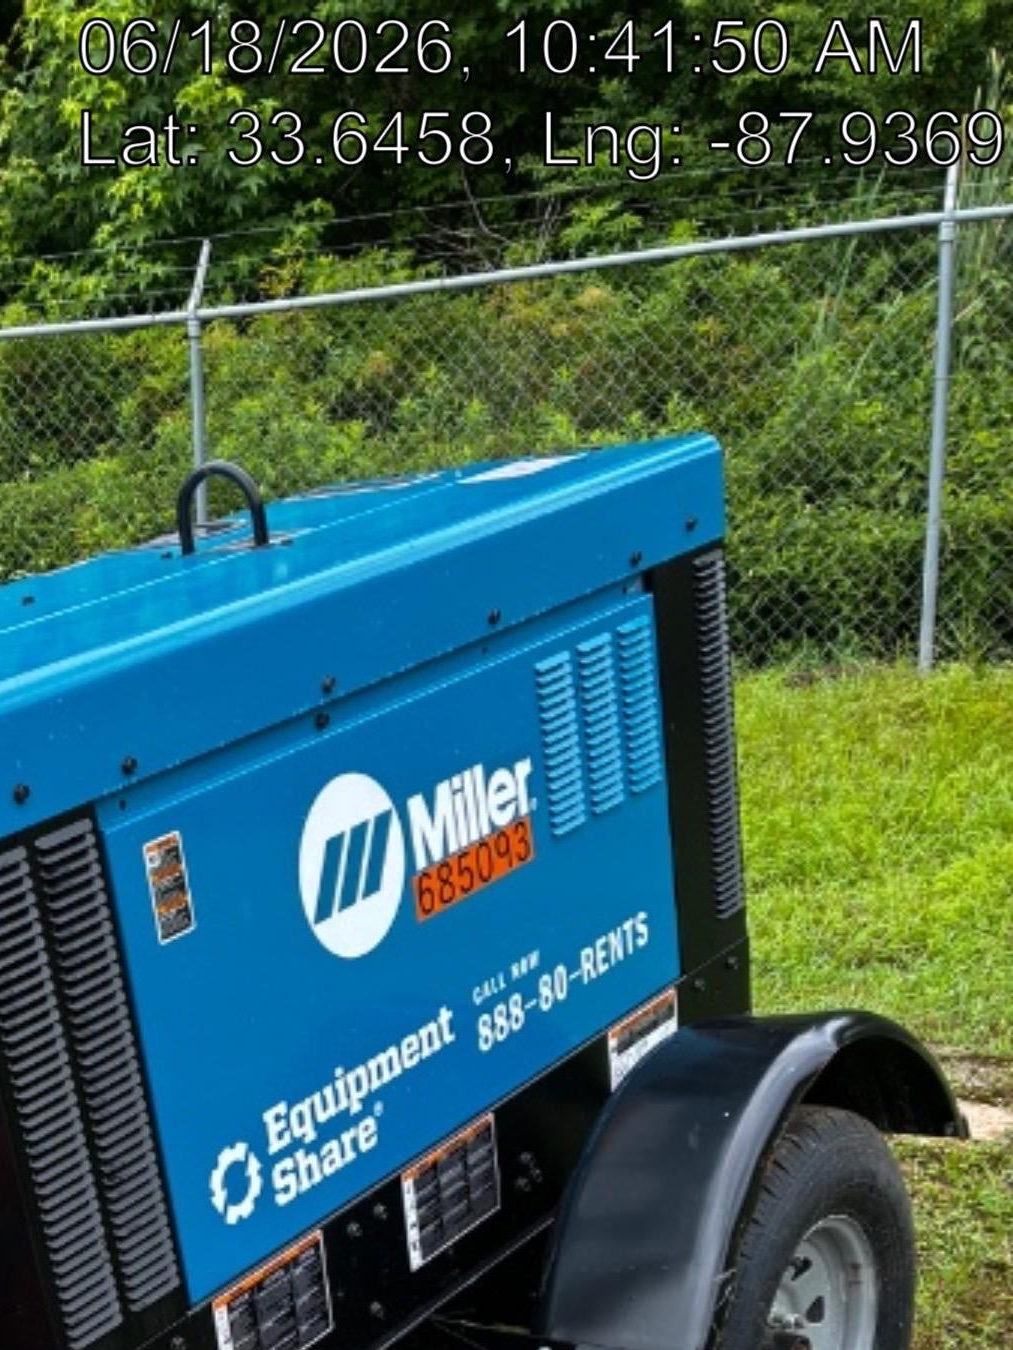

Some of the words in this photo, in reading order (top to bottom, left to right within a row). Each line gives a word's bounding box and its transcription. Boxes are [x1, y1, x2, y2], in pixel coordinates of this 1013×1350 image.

[406, 756, 535, 871] Miller
[416, 820, 533, 918] 685093
[472, 971, 507, 1006] CALL
[478, 911, 649, 1052] 888-80-RENTS
[261, 1005, 456, 1156] Equipment
